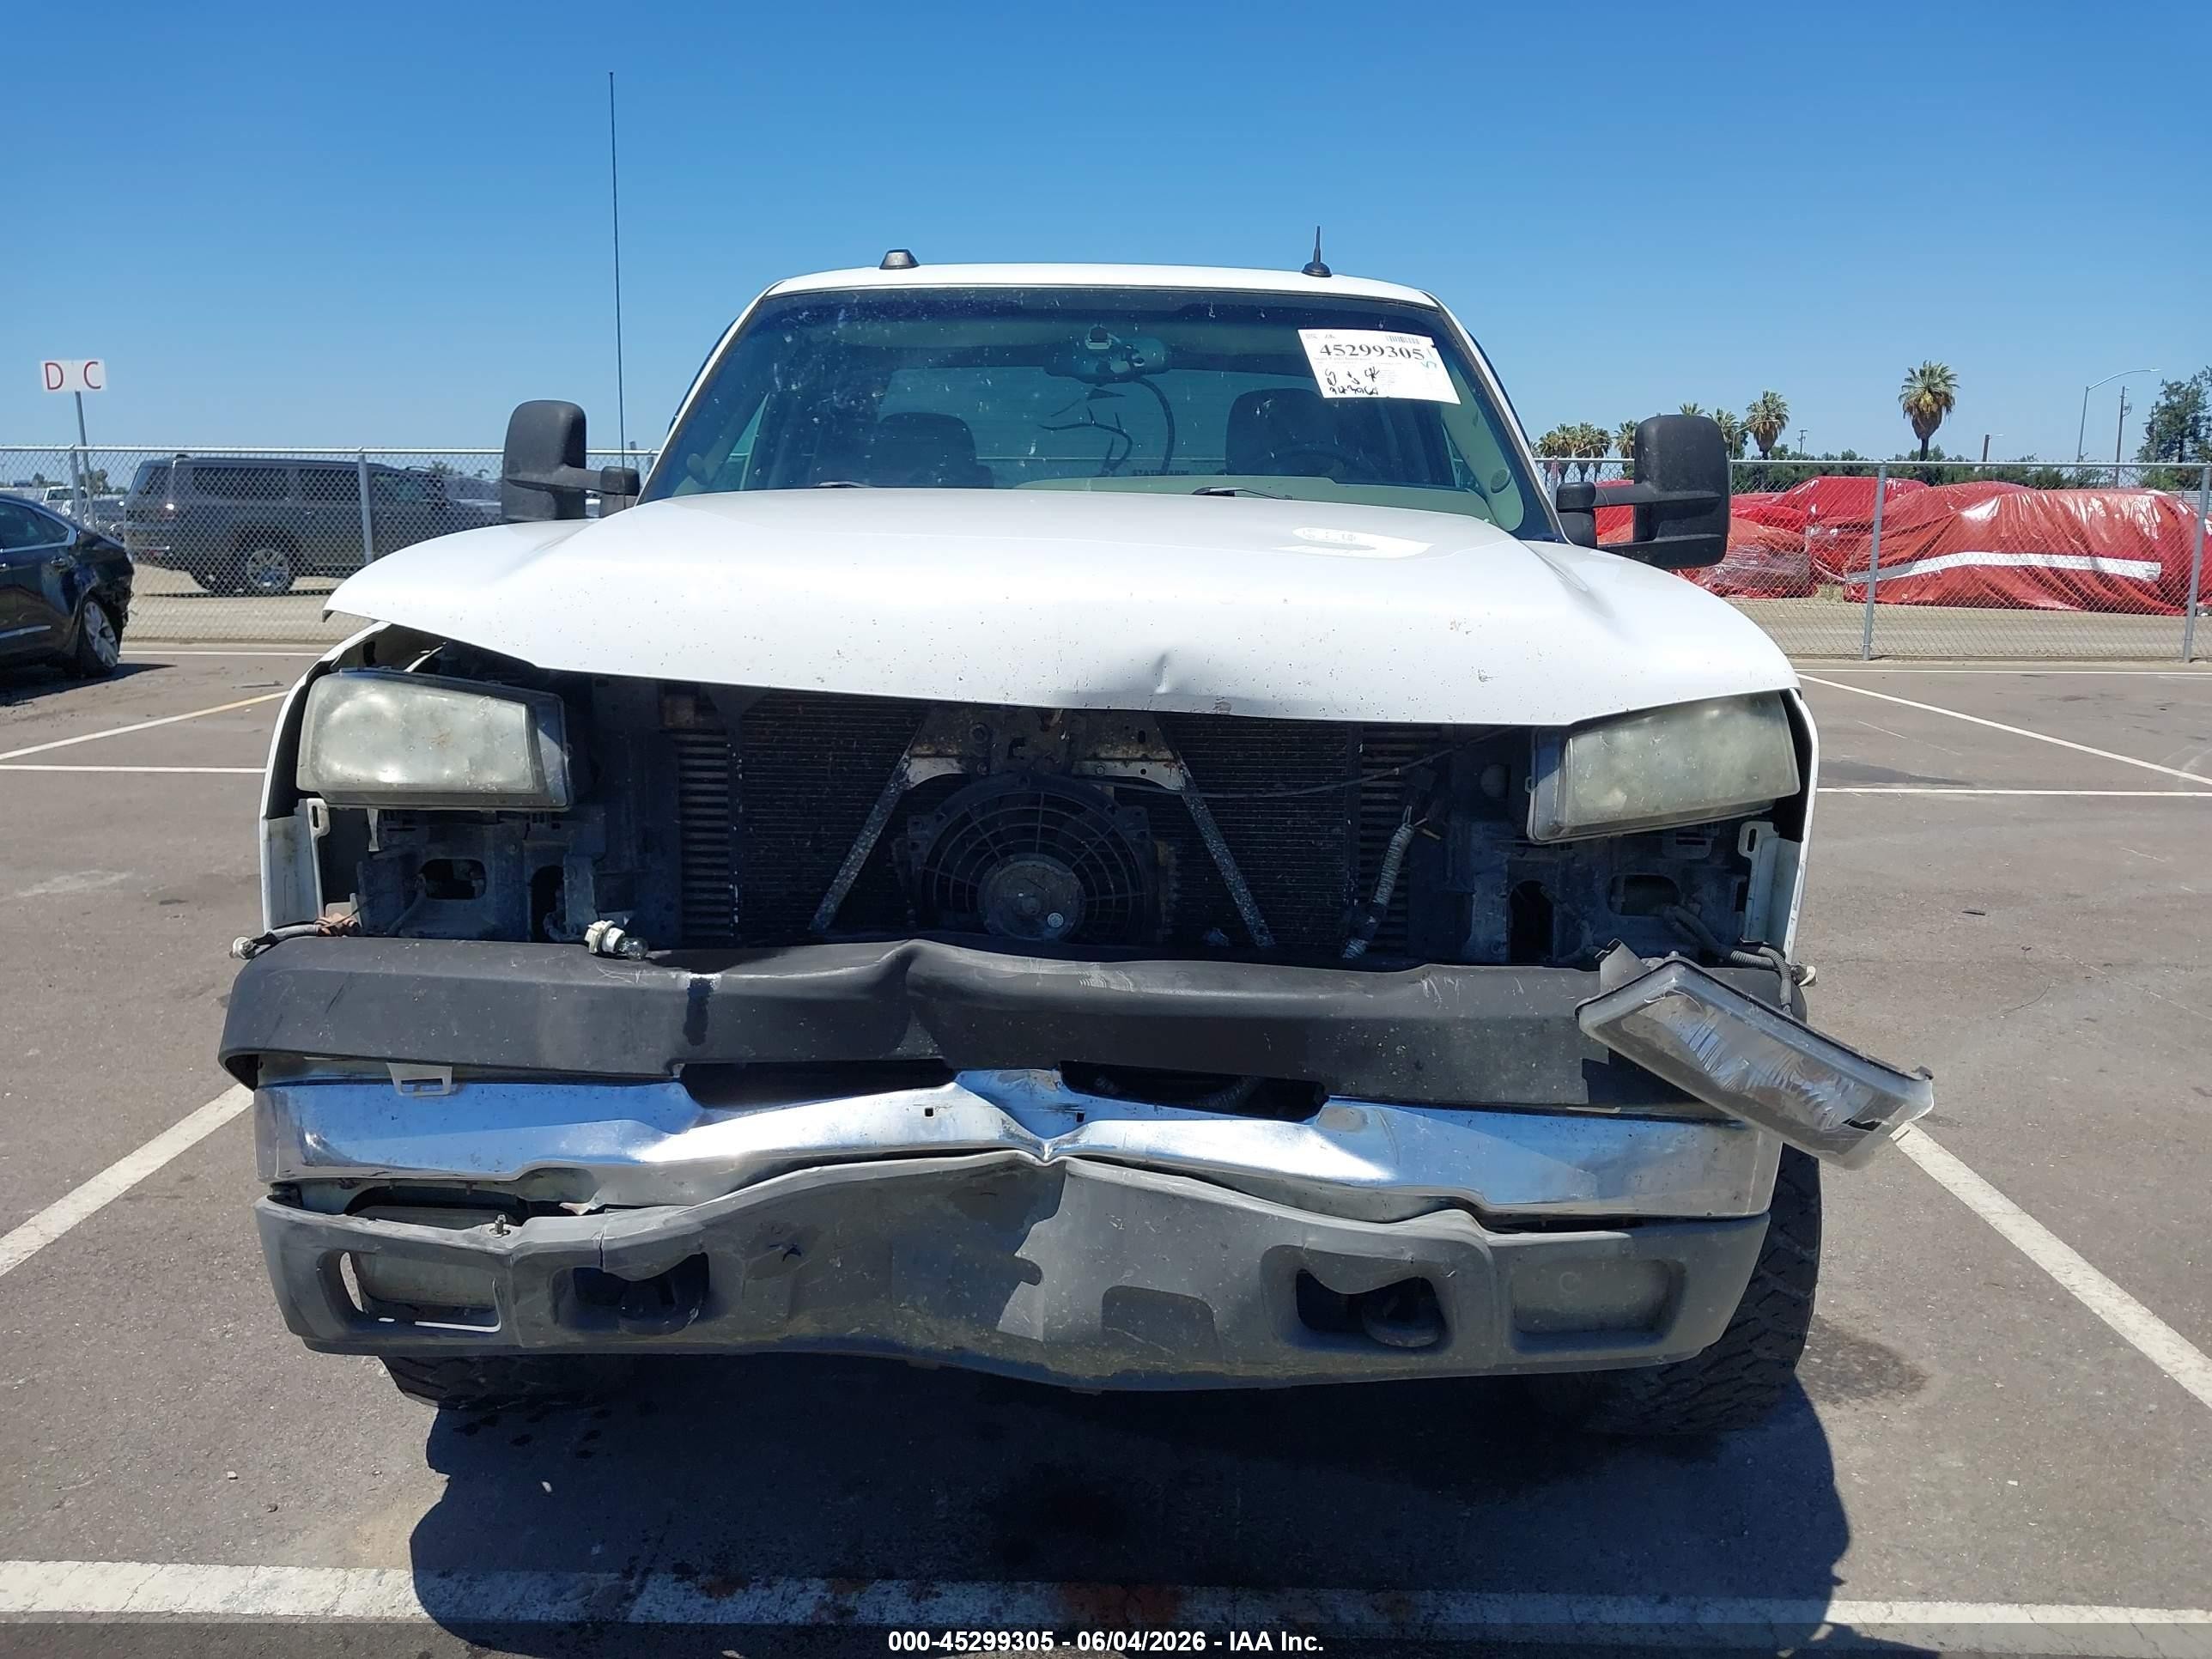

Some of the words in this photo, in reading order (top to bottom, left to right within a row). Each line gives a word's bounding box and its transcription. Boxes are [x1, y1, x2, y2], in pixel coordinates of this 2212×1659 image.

[1320, 343, 1425, 361] 45299305
[45, 362, 64, 390] D
[83, 361, 101, 390] C
